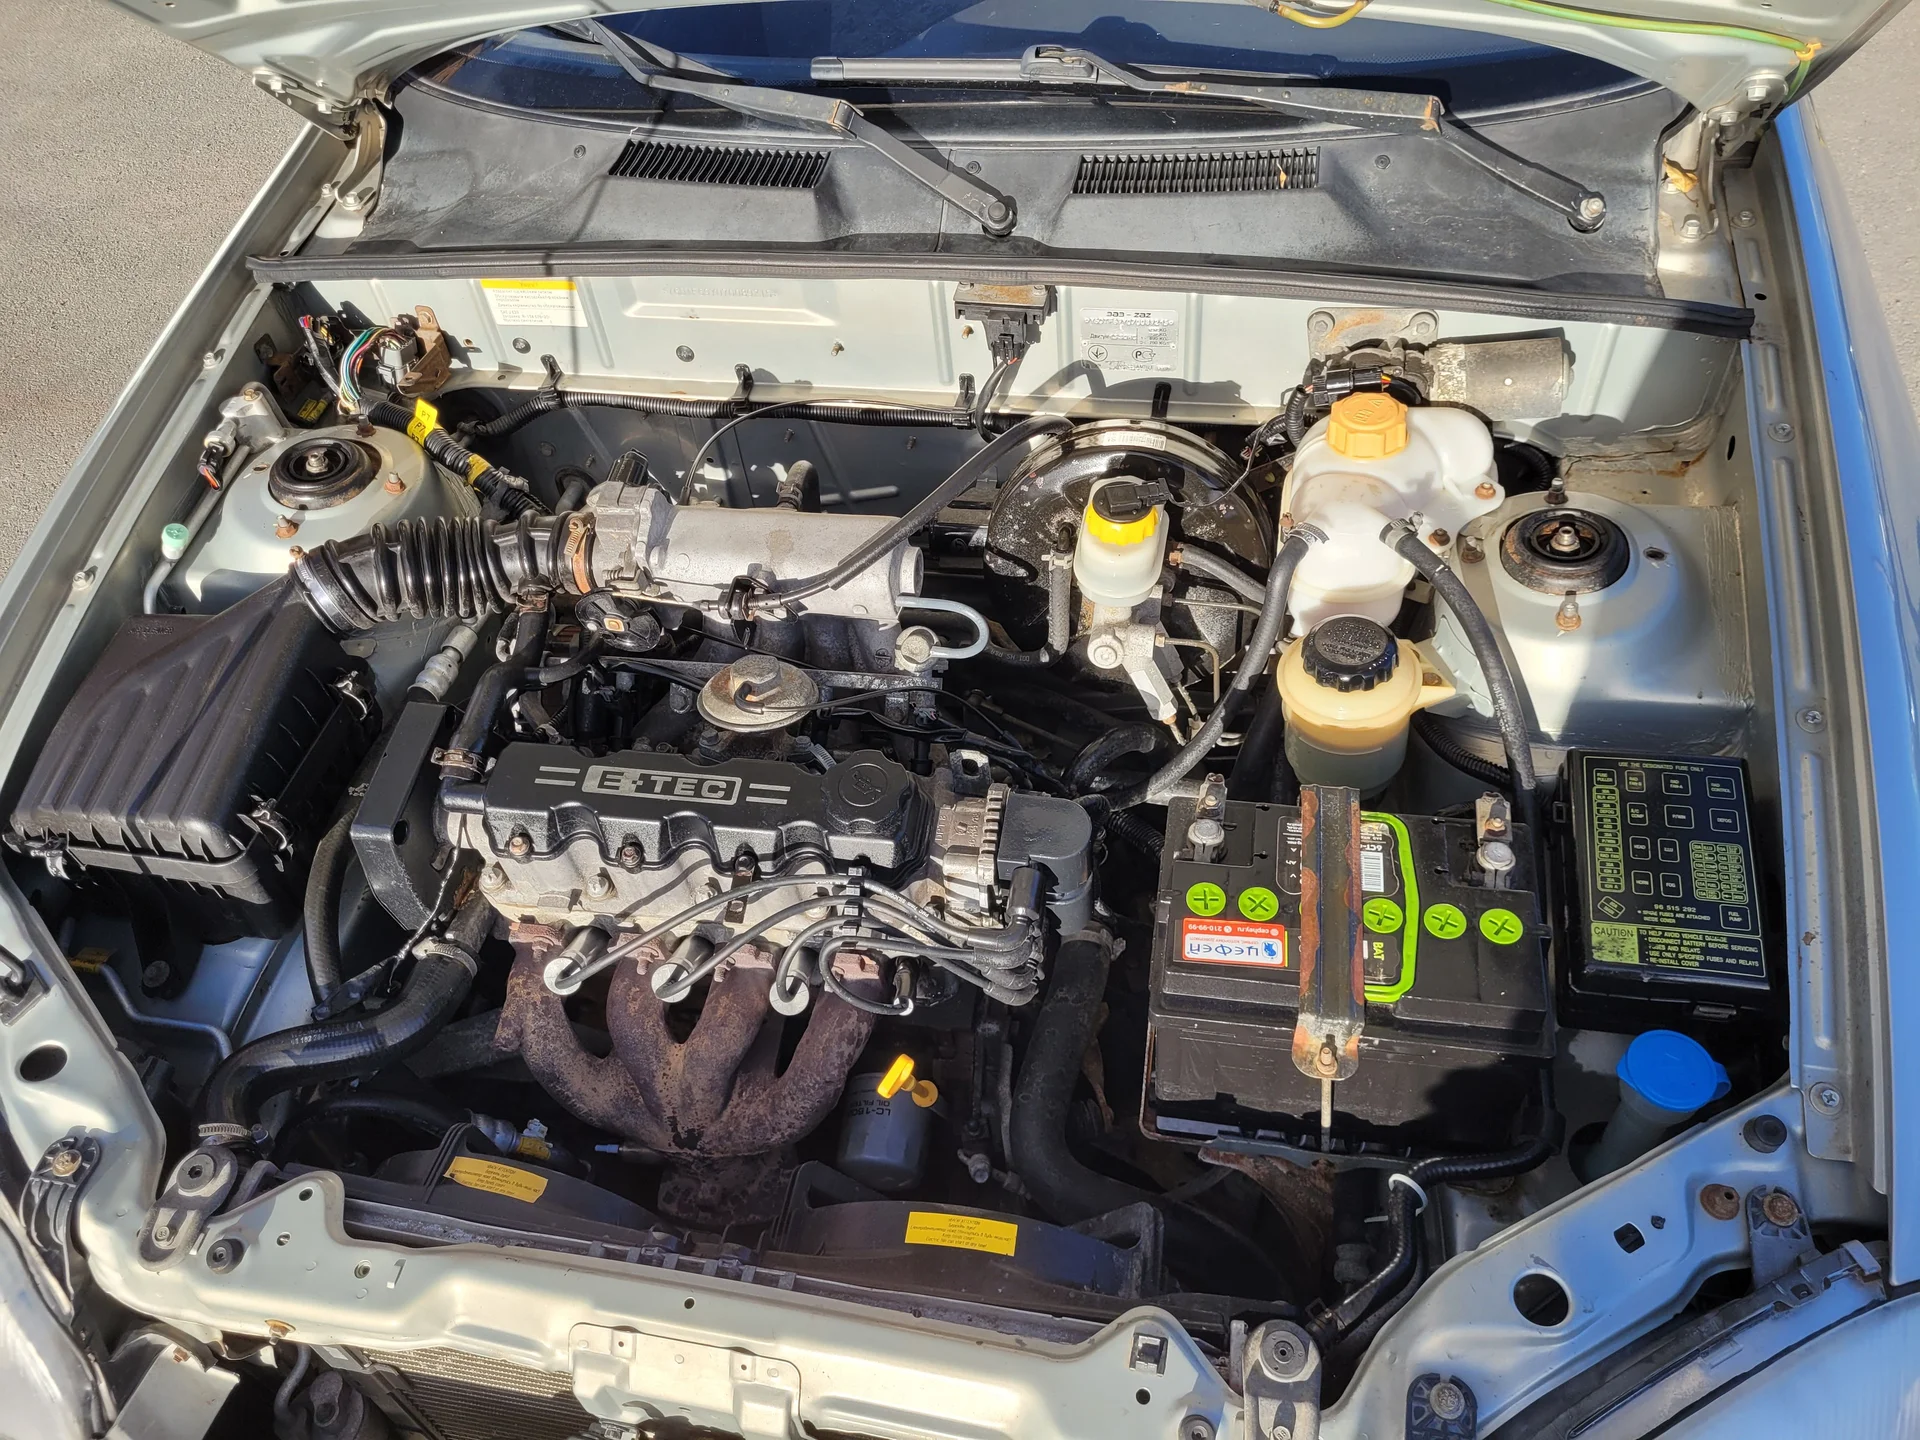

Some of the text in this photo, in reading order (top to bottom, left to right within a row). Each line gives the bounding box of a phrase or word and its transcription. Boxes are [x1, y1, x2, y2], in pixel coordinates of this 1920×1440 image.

[421, 410, 431, 420] P7
[414, 421, 426, 433] P7
[1642, 762, 1674, 770] DESIGNATED
[1675, 764, 1689, 772] FUSE
[1187, 923, 1223, 932] 210-99-99
[1237, 926, 1270, 934] cephey.ru
[1593, 926, 1634, 938] CAUTION
[1681, 932, 1704, 940] VEHICLE
[1648, 937, 1758, 953] DISCONNECT BATTERY BEFORE SERVICING
[1372, 941, 1385, 961] BAT
[1680, 946, 1701, 954] RELAYS
[1649, 957, 1680, 966] RE-INSTALL
[1738, 959, 1759, 967] RELAYS
